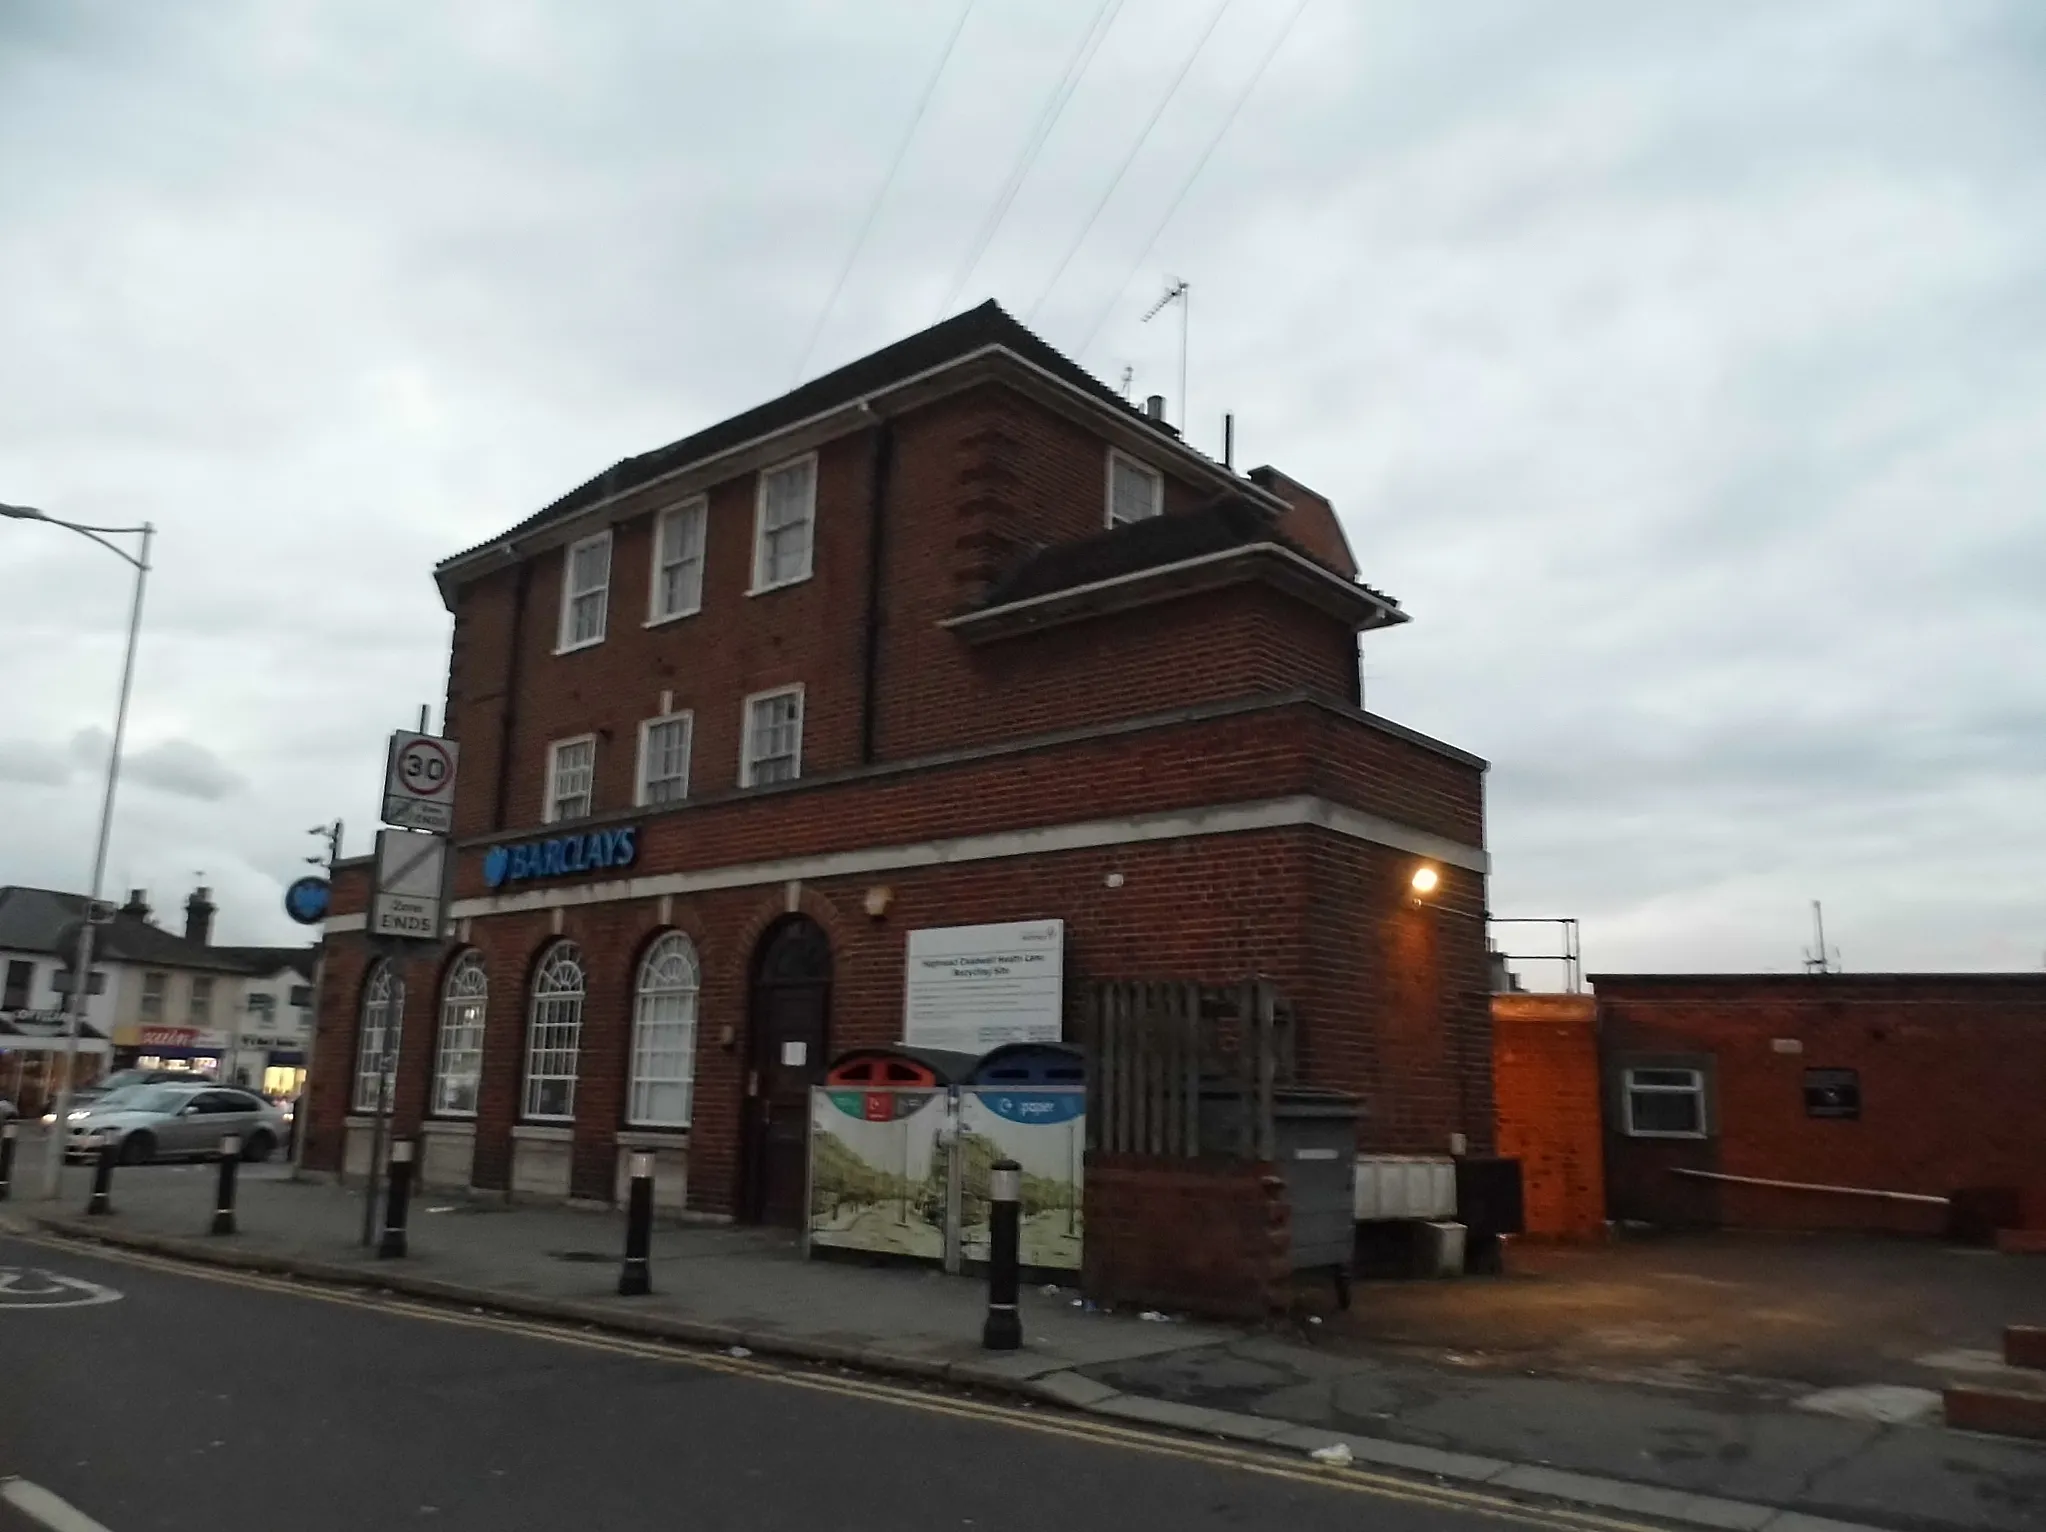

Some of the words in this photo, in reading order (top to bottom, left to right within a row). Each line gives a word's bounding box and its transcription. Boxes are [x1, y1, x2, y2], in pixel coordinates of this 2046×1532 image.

[406, 754, 445, 781] 30
[508, 827, 635, 880] BARCLAYS
[381, 914, 432, 931] ENDS
[1020, 1101, 1055, 1117] paper
